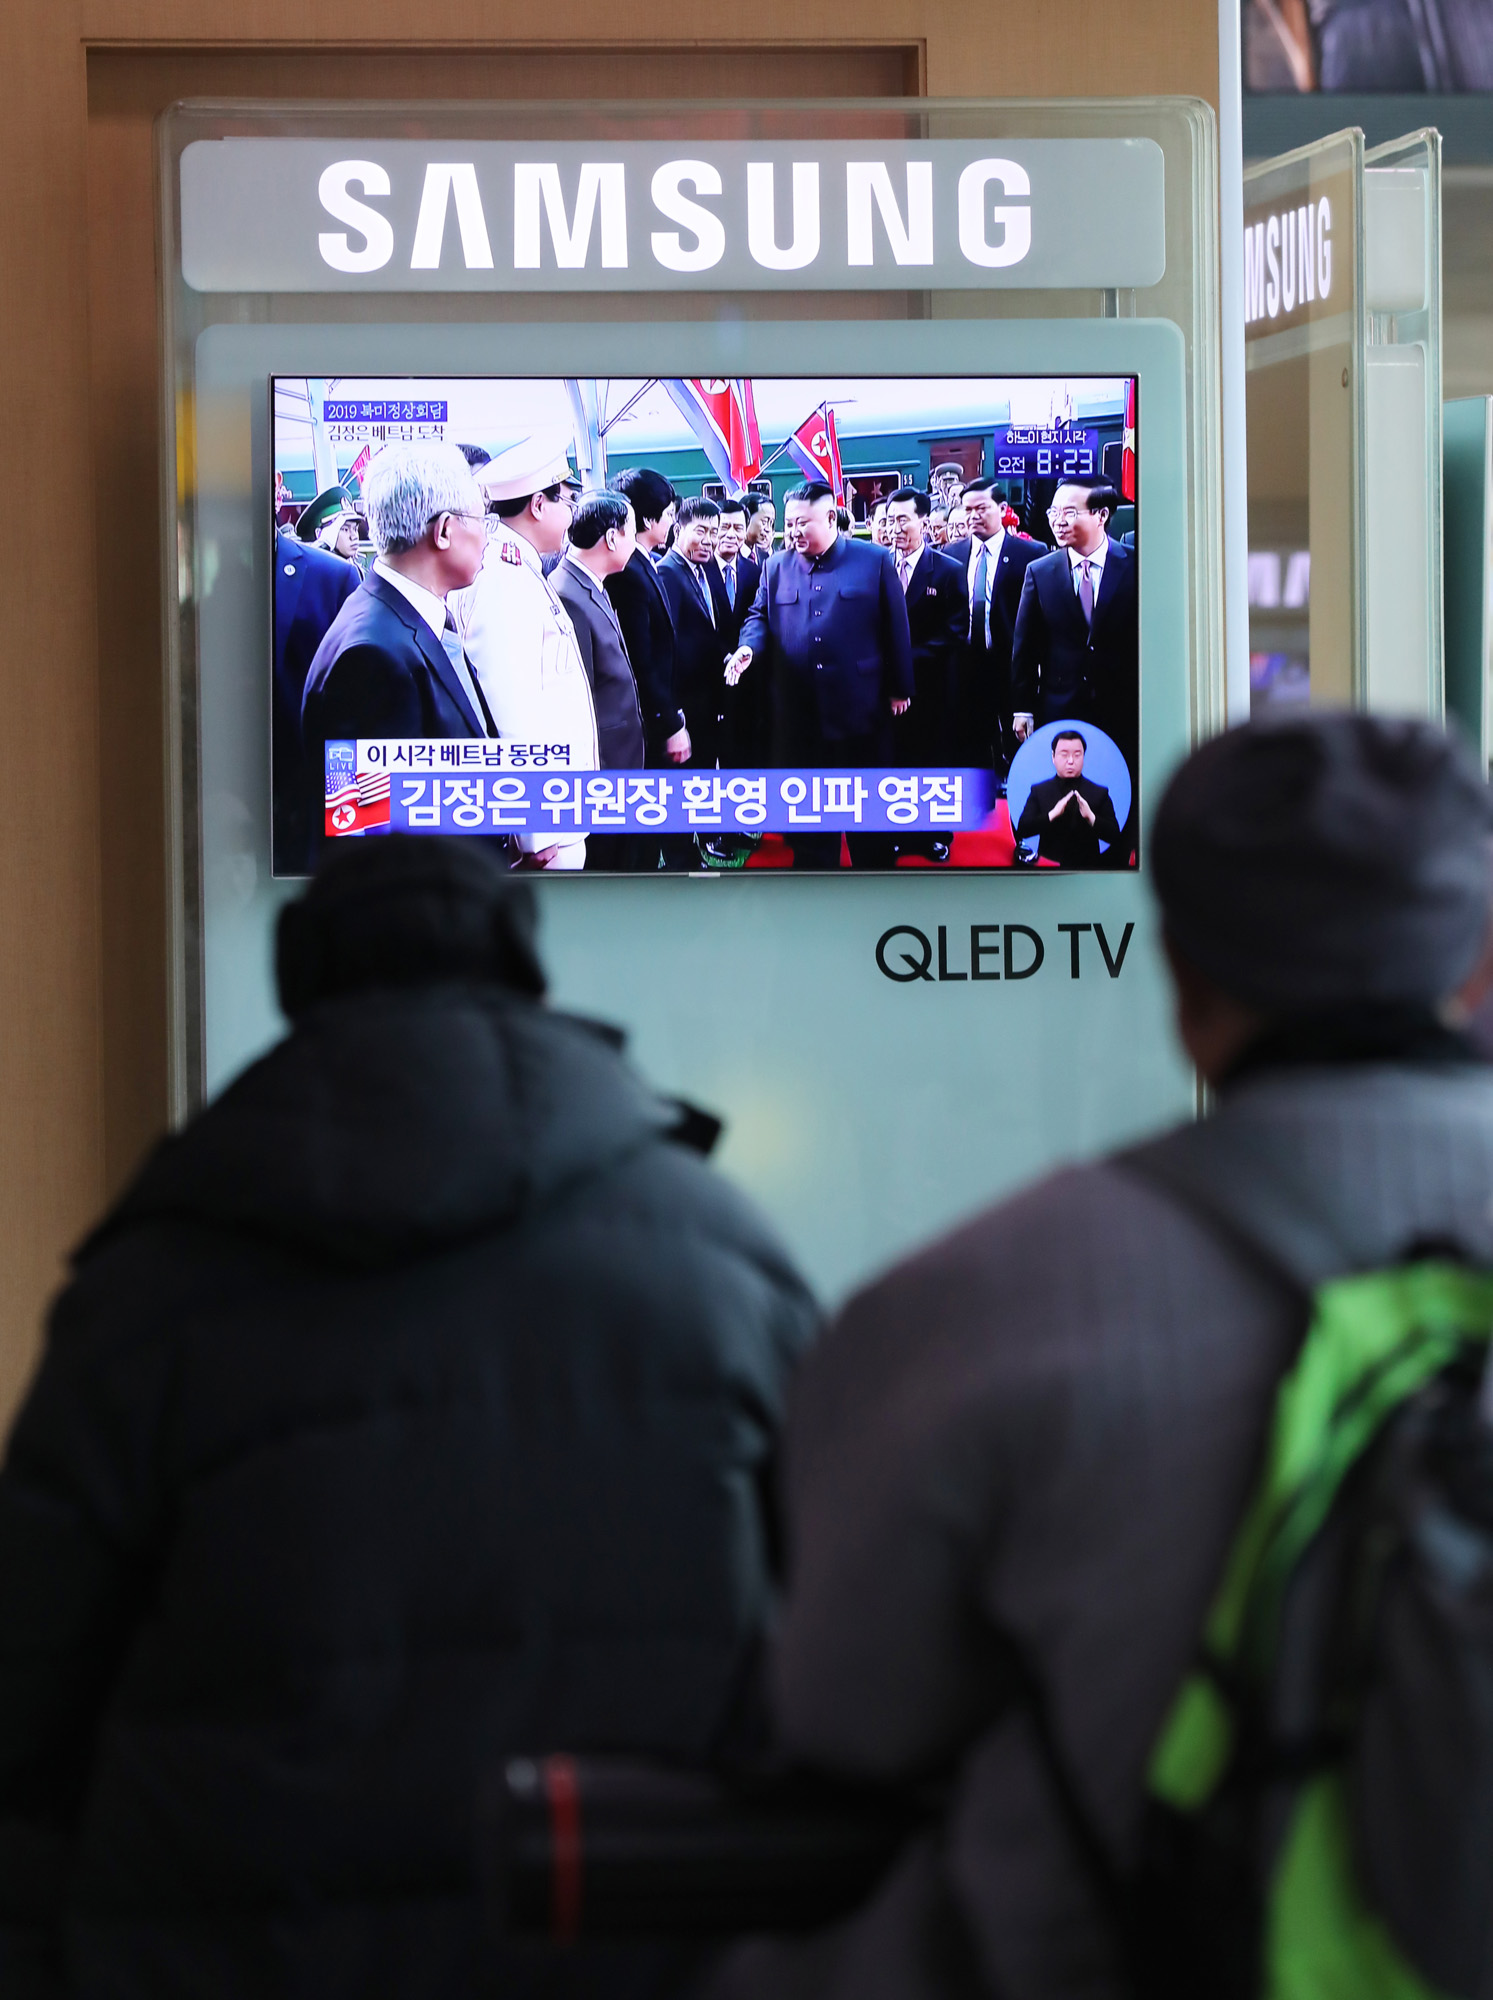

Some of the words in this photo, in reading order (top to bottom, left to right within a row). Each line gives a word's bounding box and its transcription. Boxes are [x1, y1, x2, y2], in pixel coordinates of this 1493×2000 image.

[317, 158, 1032, 273] SAMSUNG
[1244, 196, 1332, 322] MSUNG
[328, 404, 357, 419] 2019
[360, 402, 444, 419] 북미정상회담
[328, 424, 370, 441] 김정은
[372, 424, 414, 441] 베트남
[416, 424, 445, 441] 도착
[1006, 430, 1039, 444] 하노이
[1040, 430, 1063, 444] 현지
[1064, 430, 1087, 444] 시각
[997, 456, 1026, 474] 오전
[1036, 448, 1093, 474] 8:23
[329, 762, 353, 770] LIVE
[367, 745, 387, 766] 이
[393, 745, 436, 766] 시각
[440, 745, 503, 767] 베트남
[507, 743, 571, 766] 동당역
[400, 777, 531, 828] 김정은
[540, 776, 673, 826] 위원장
[681, 775, 767, 825] 환영
[780, 775, 868, 823] 인파
[877, 774, 963, 823] 영접
[875, 924, 1045, 983] QLED
[1057, 922, 1135, 979] TV
